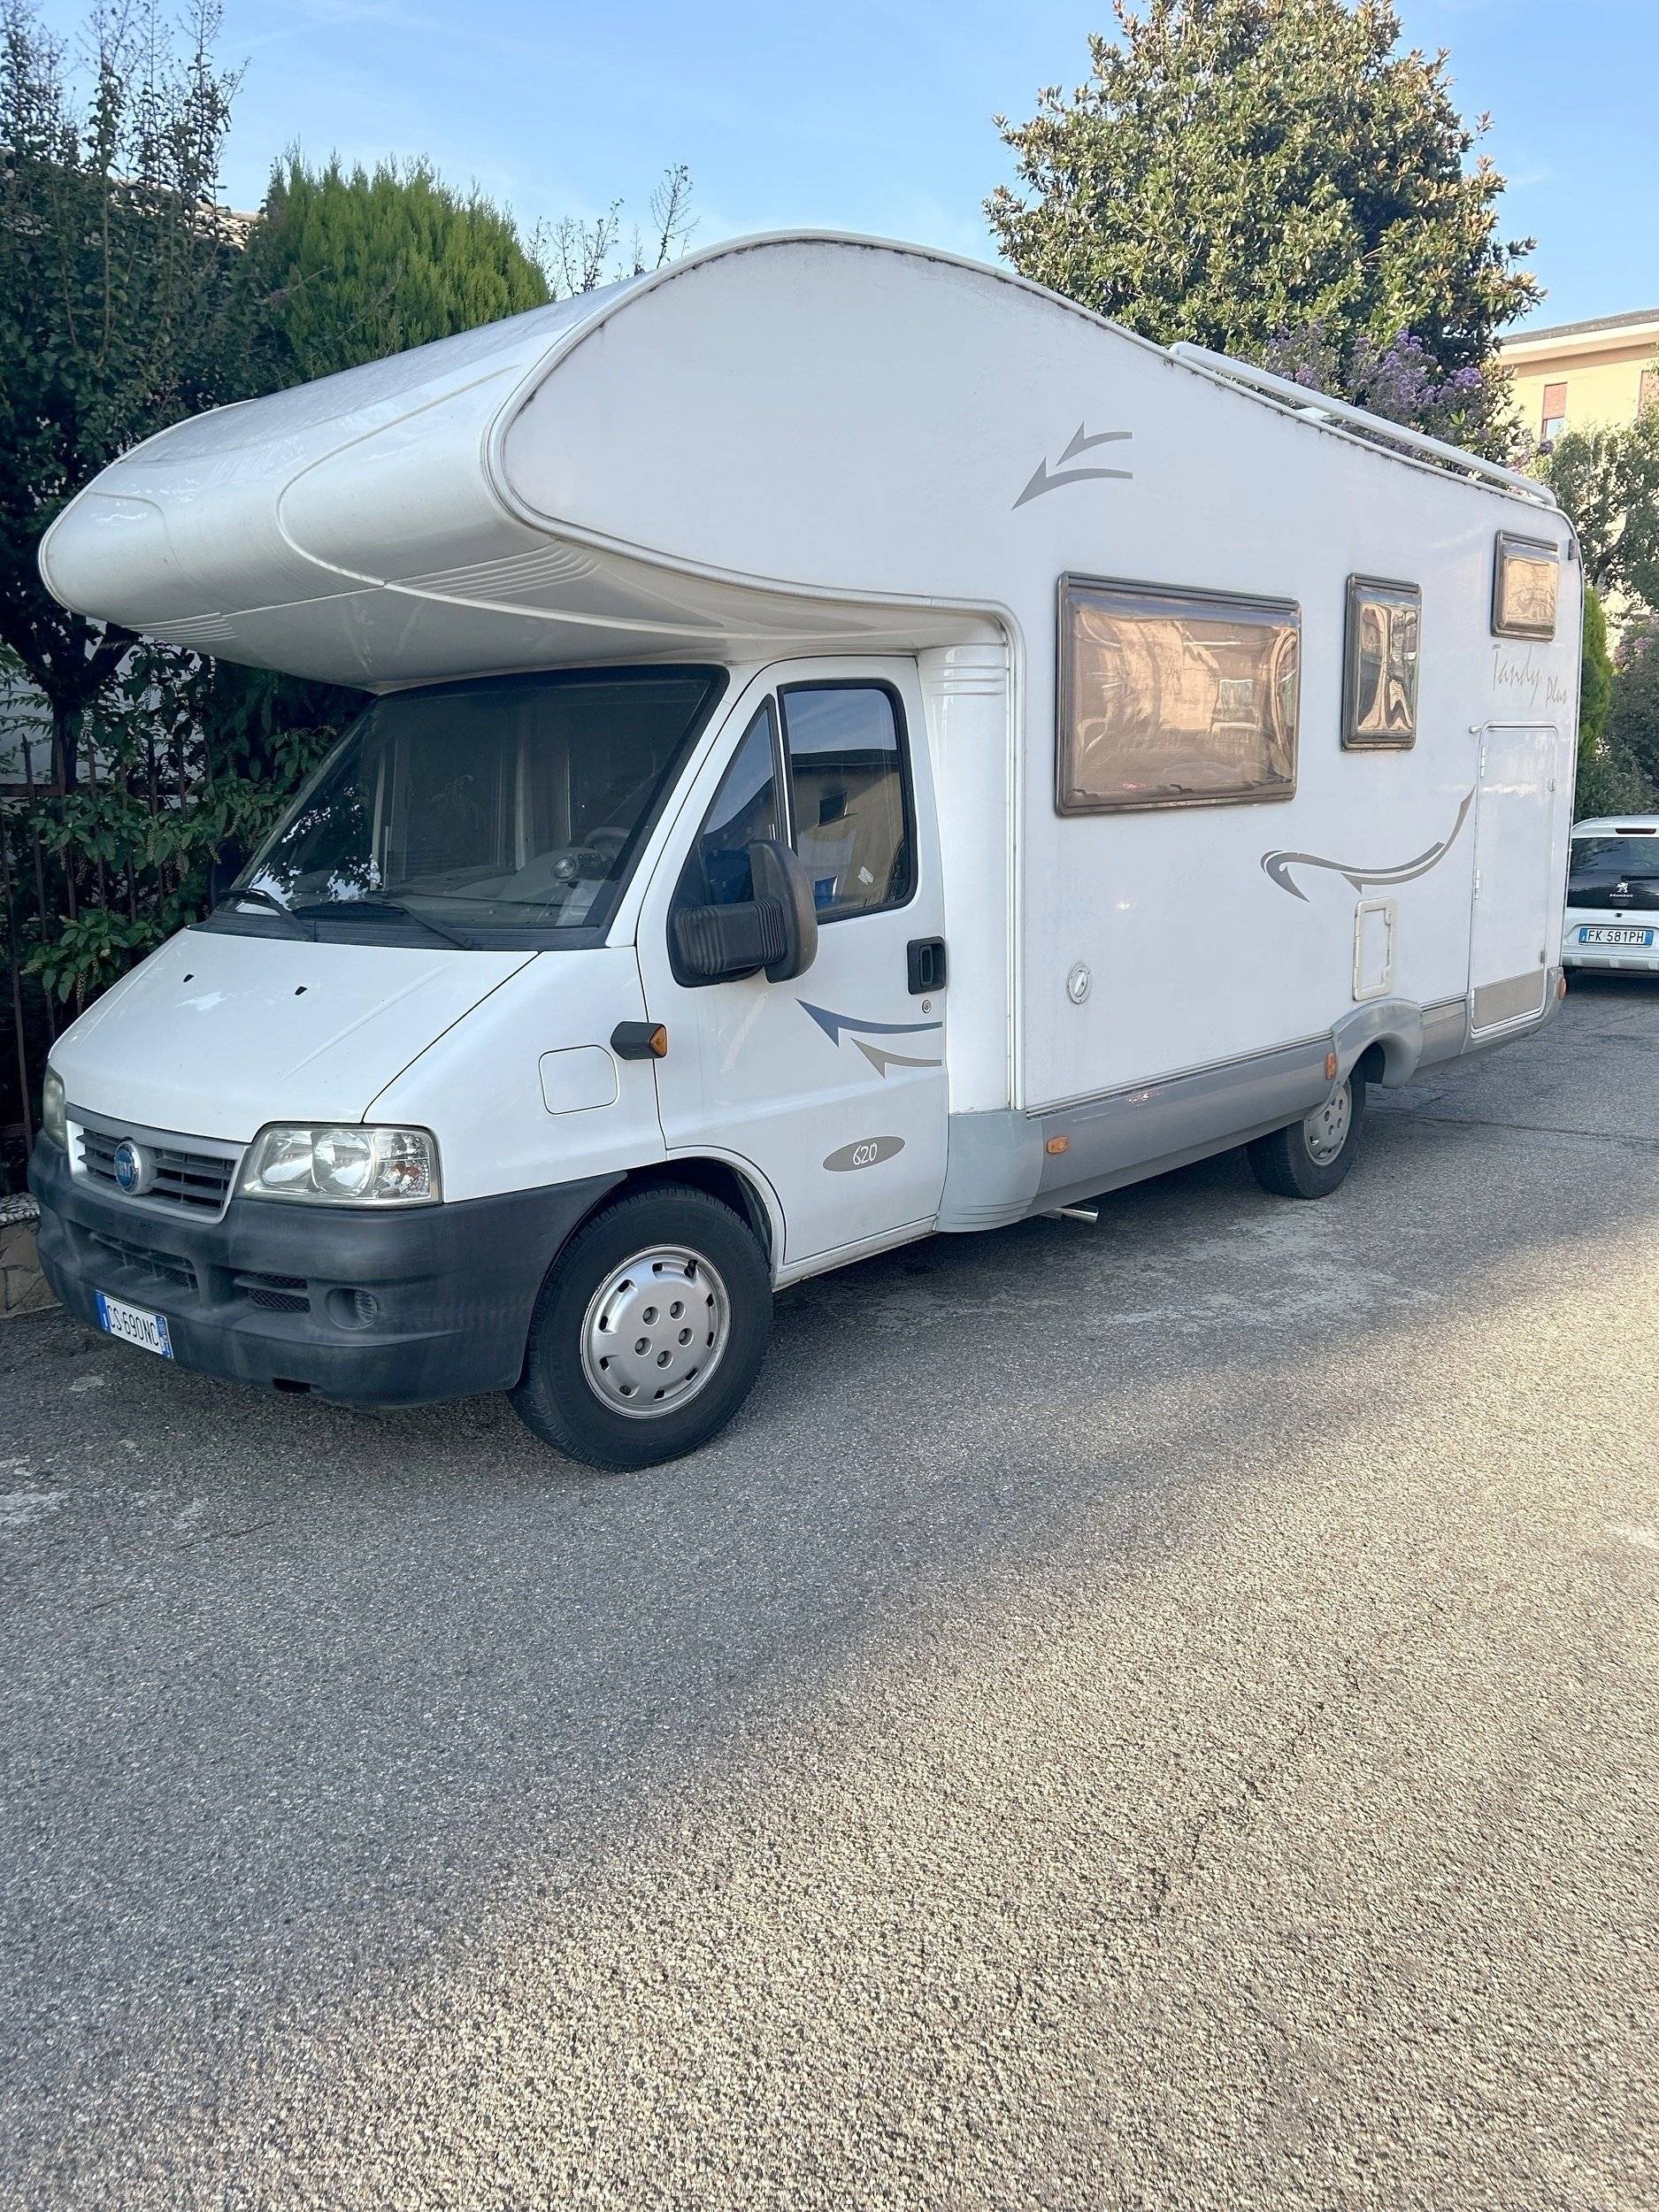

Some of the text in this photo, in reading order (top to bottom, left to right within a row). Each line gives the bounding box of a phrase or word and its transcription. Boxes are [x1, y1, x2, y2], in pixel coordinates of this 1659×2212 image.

[1493, 643, 1541, 707] Tandy
[1587, 930, 1602, 941] FK
[1606, 931, 1644, 942] 581PH
[852, 1142, 877, 1165] 620
[107, 1304, 122, 1332] CS
[122, 1311, 158, 1346] 690NC
